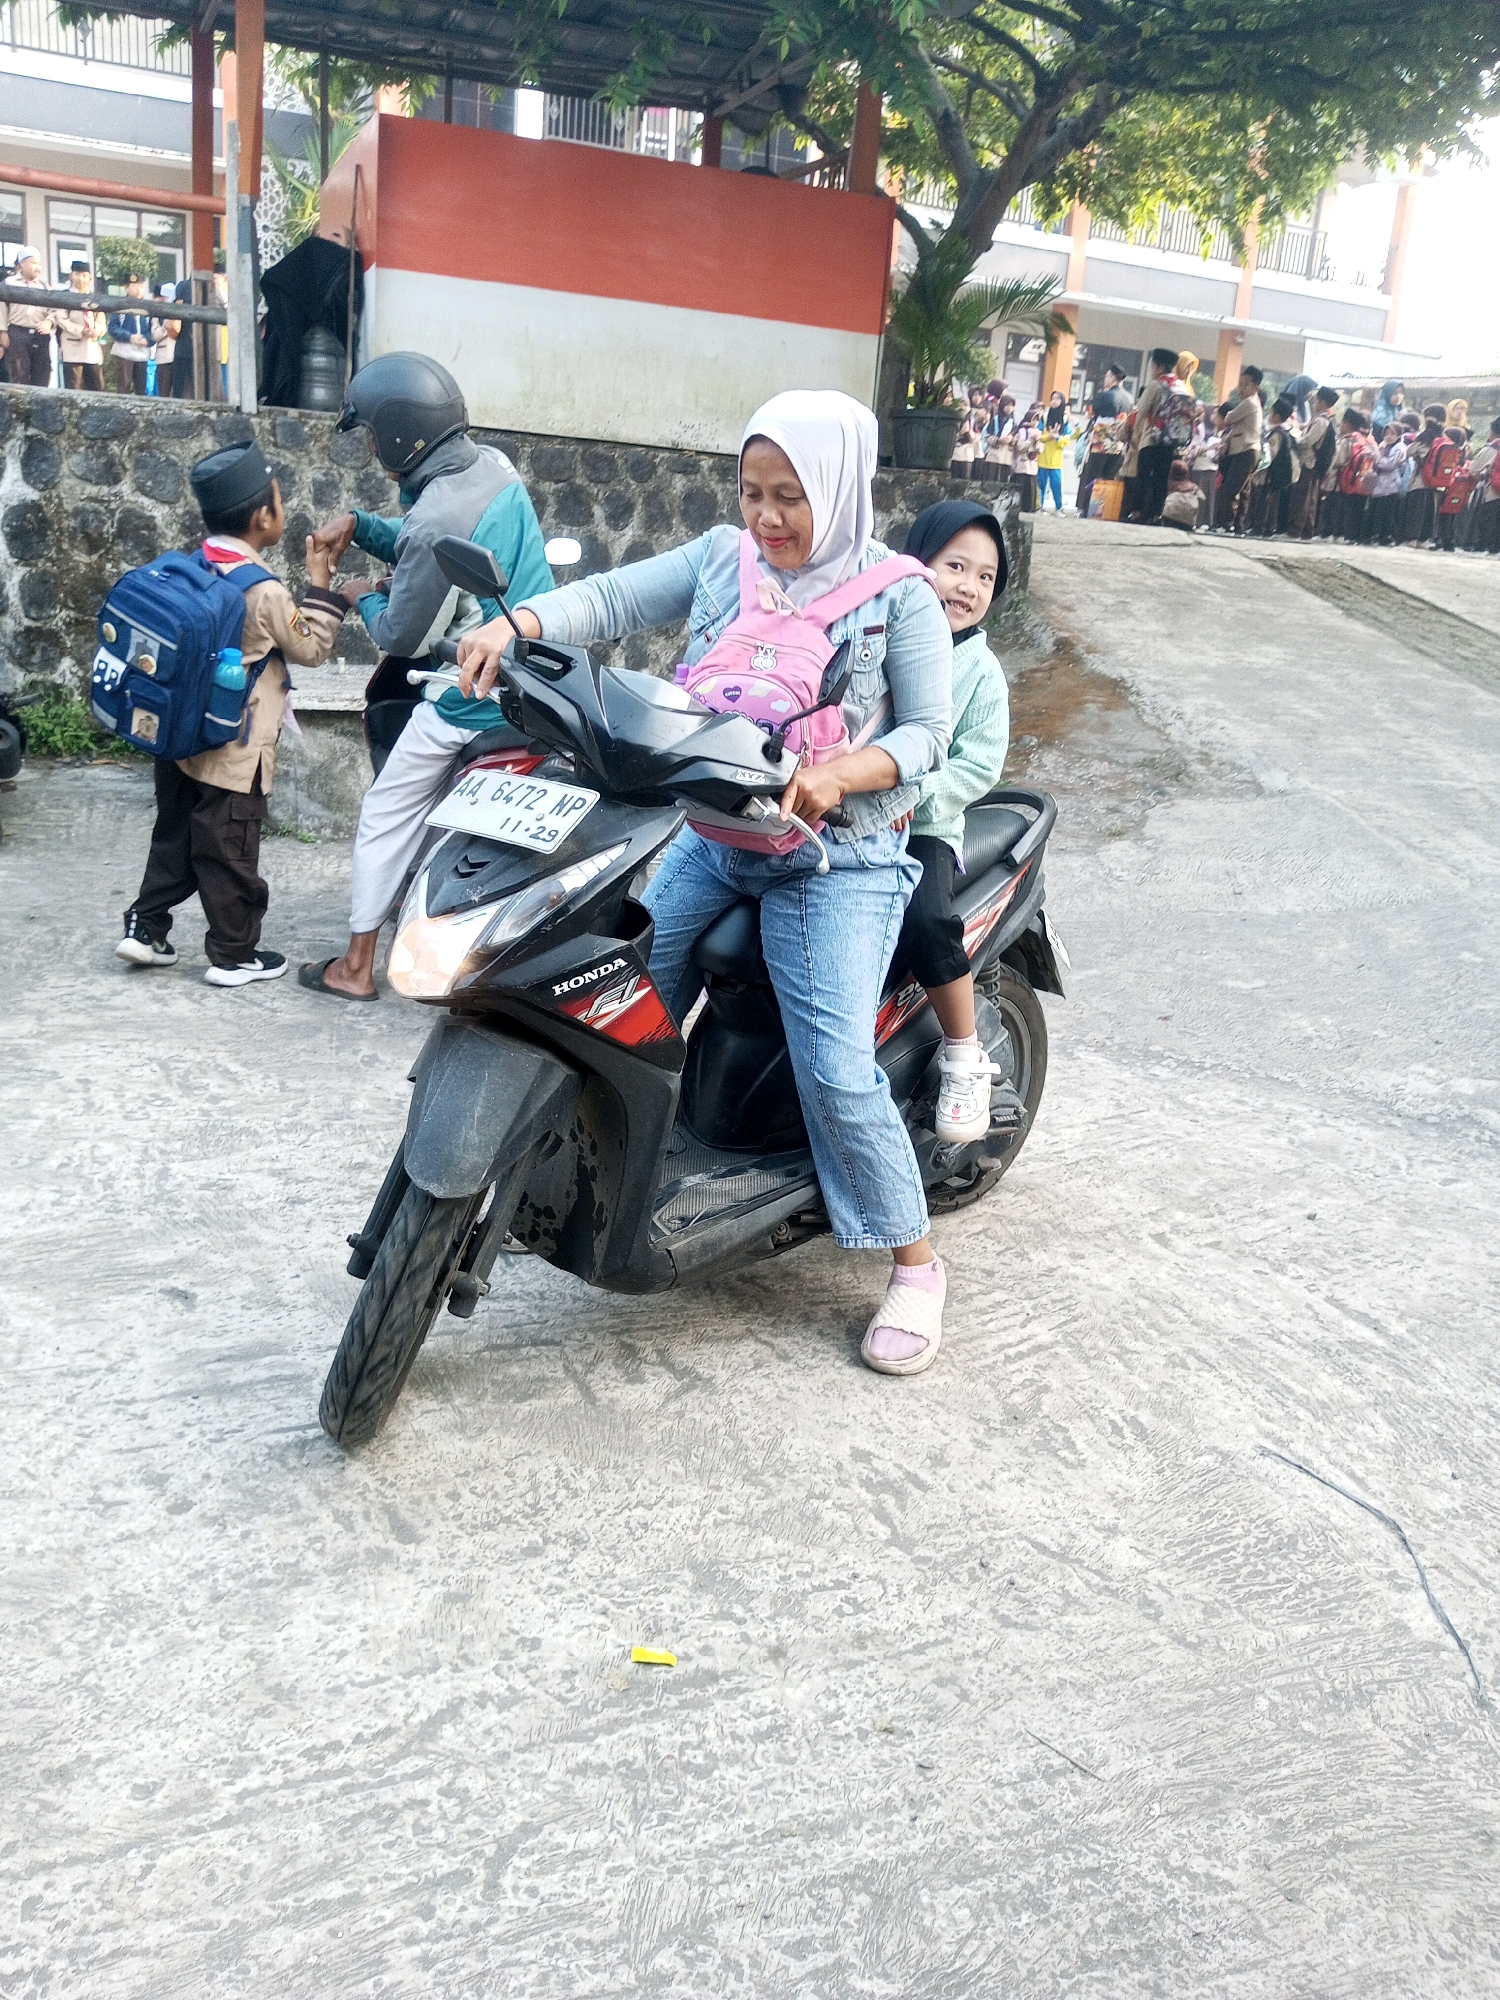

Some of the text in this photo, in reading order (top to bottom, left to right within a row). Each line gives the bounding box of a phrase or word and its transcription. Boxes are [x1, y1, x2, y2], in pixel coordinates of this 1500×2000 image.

[453, 775, 588, 818] AA 6472 NP
[552, 957, 628, 997] HONDA
